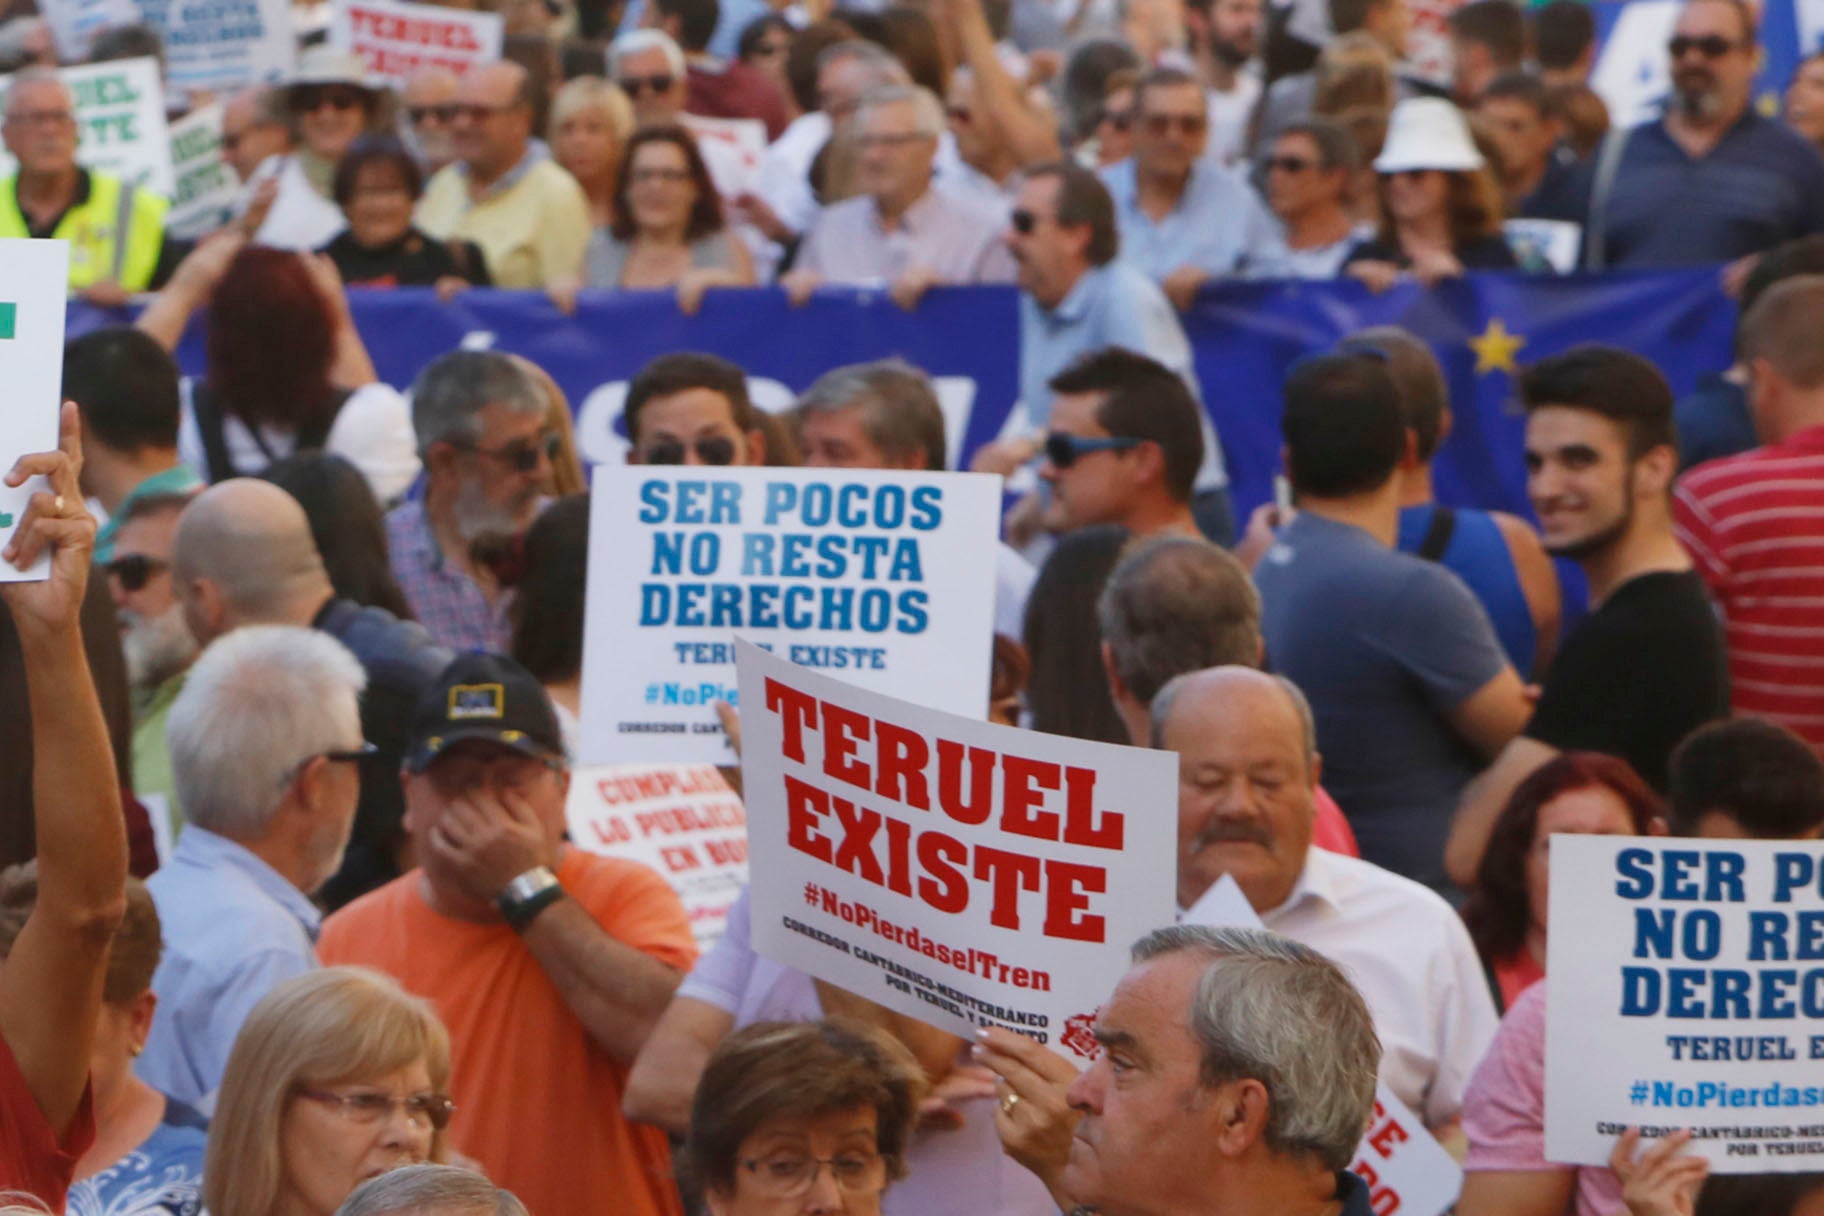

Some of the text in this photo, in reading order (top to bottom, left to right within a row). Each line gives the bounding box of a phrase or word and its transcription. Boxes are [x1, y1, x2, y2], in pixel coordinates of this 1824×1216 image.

[638, 479, 944, 531] SER POCOS
[650, 532, 923, 582] NO RESTA
[638, 582, 930, 634] DERECHOS
[790, 645, 886, 669] EXISTE
[764, 676, 1125, 850] TERUEL
[784, 773, 1107, 944] EXISTE
[1614, 847, 1746, 901] SER
[782, 914, 850, 954] CORREDOR
[803, 881, 1052, 992] #NoPierdaselTren
[1632, 907, 1722, 961] NO
[886, 975, 912, 994] POR
[915, 983, 964, 1018] TERUEL
[1666, 1035, 1796, 1061] TERUEL
